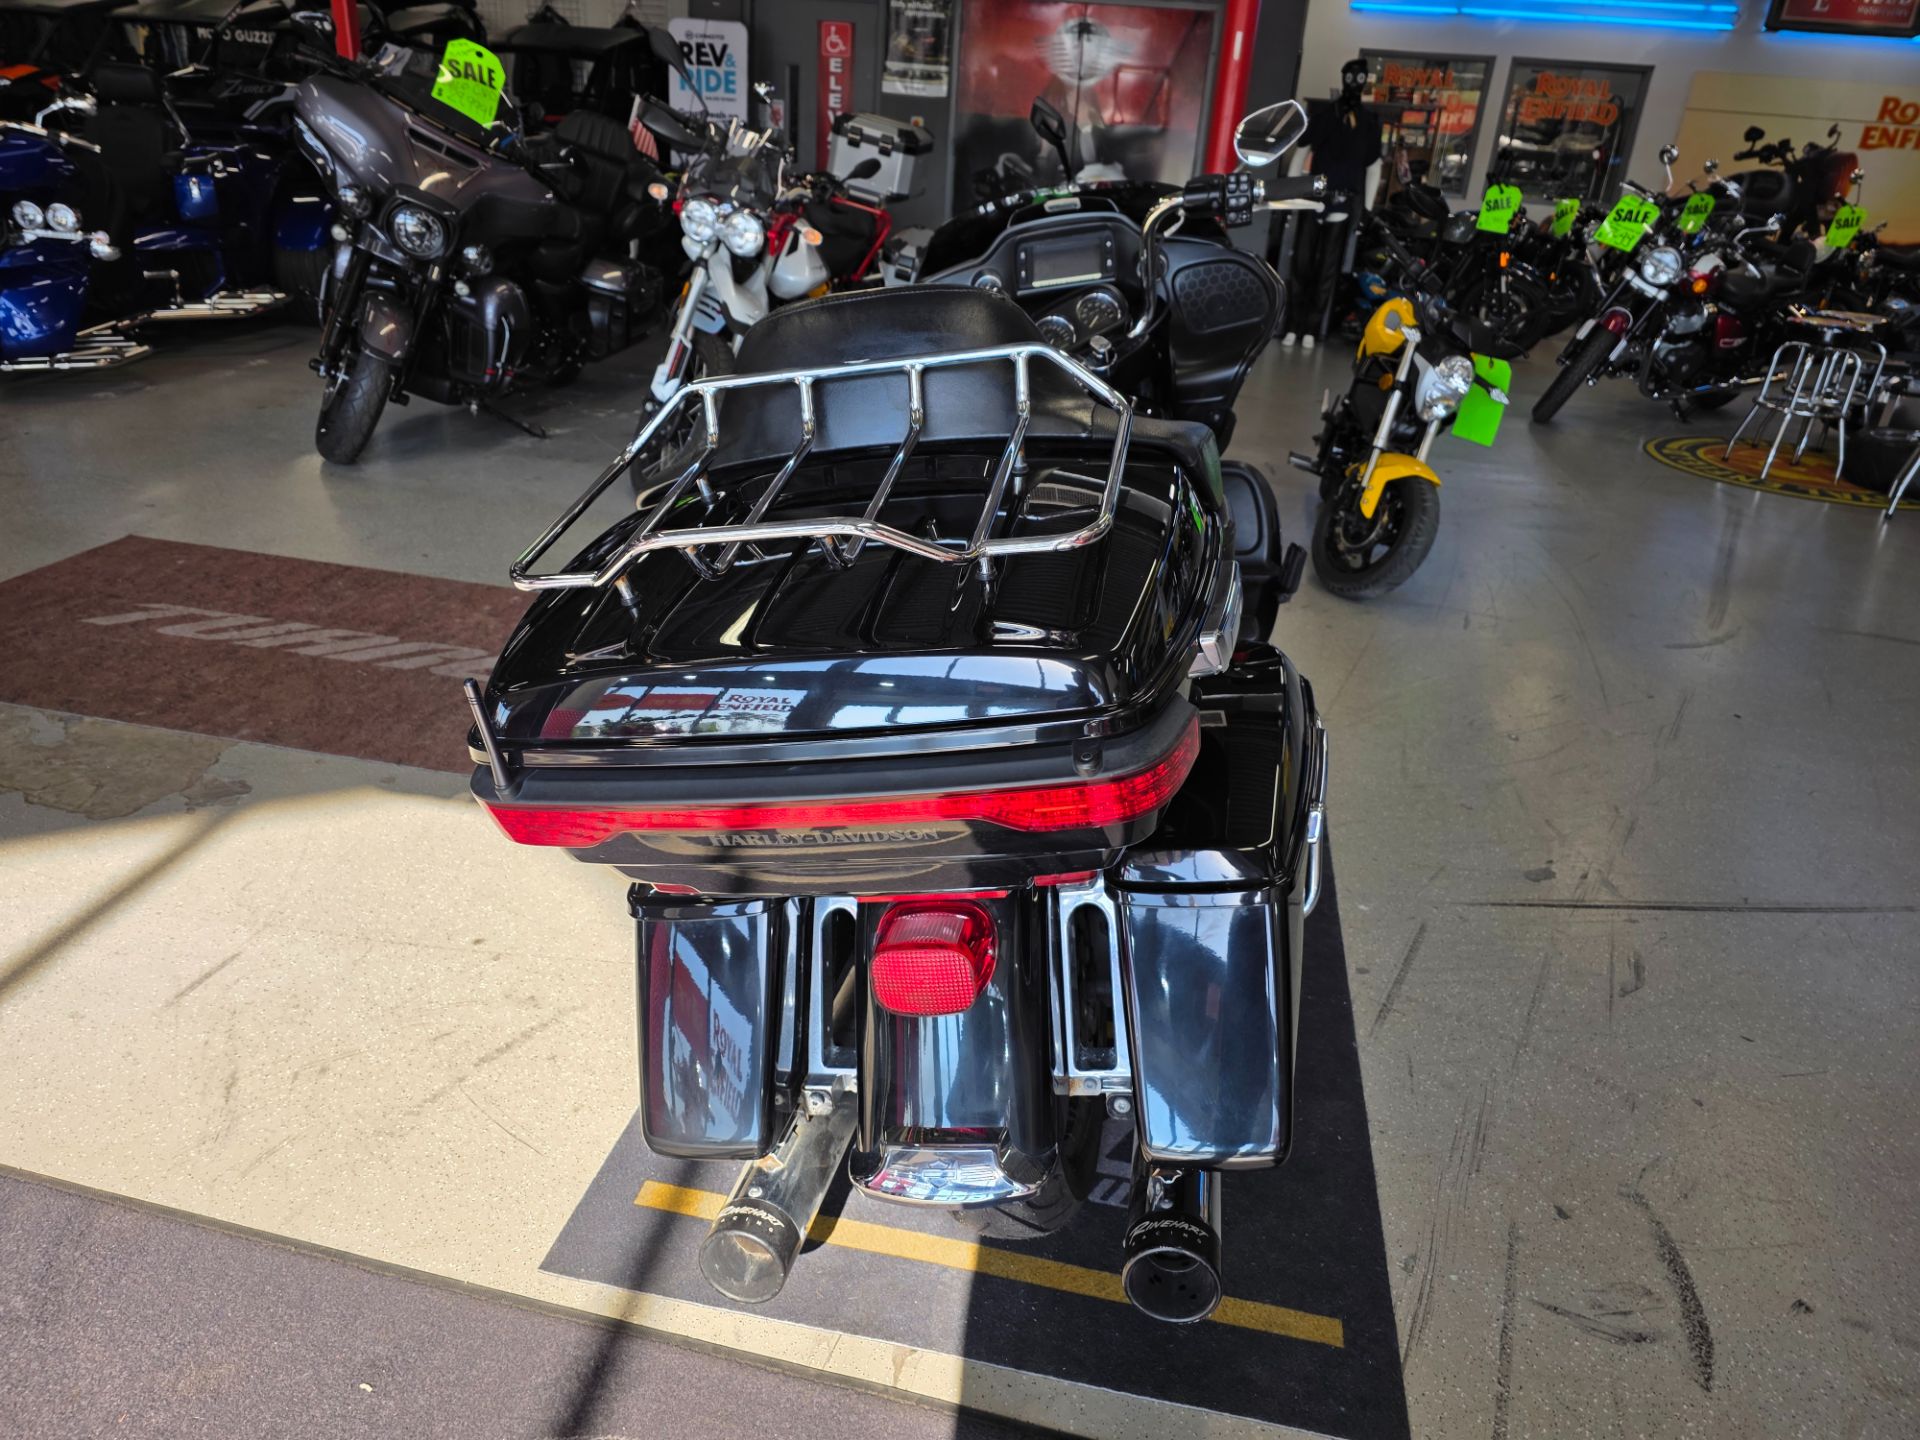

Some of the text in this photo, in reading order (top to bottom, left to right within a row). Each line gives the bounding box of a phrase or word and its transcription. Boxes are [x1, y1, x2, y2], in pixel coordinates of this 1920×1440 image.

[447, 58, 498, 91] SALE
[680, 68, 737, 95] RIDE
[1383, 63, 1455, 89] ROYAL
[1535, 71, 1611, 99] ROYAL
[1519, 97, 1619, 126] ENFIELD
[1485, 196, 1513, 212] SALE
[1613, 208, 1652, 223] SALE
[1686, 203, 1710, 215] SALE
[1835, 215, 1861, 230] SALE
[726, 694, 792, 705] ROYAL
[708, 827, 941, 848] HARLEY-DAVIDSON
[719, 1205, 785, 1228] RINEHART
[1128, 1219, 1209, 1246] RINEHART
